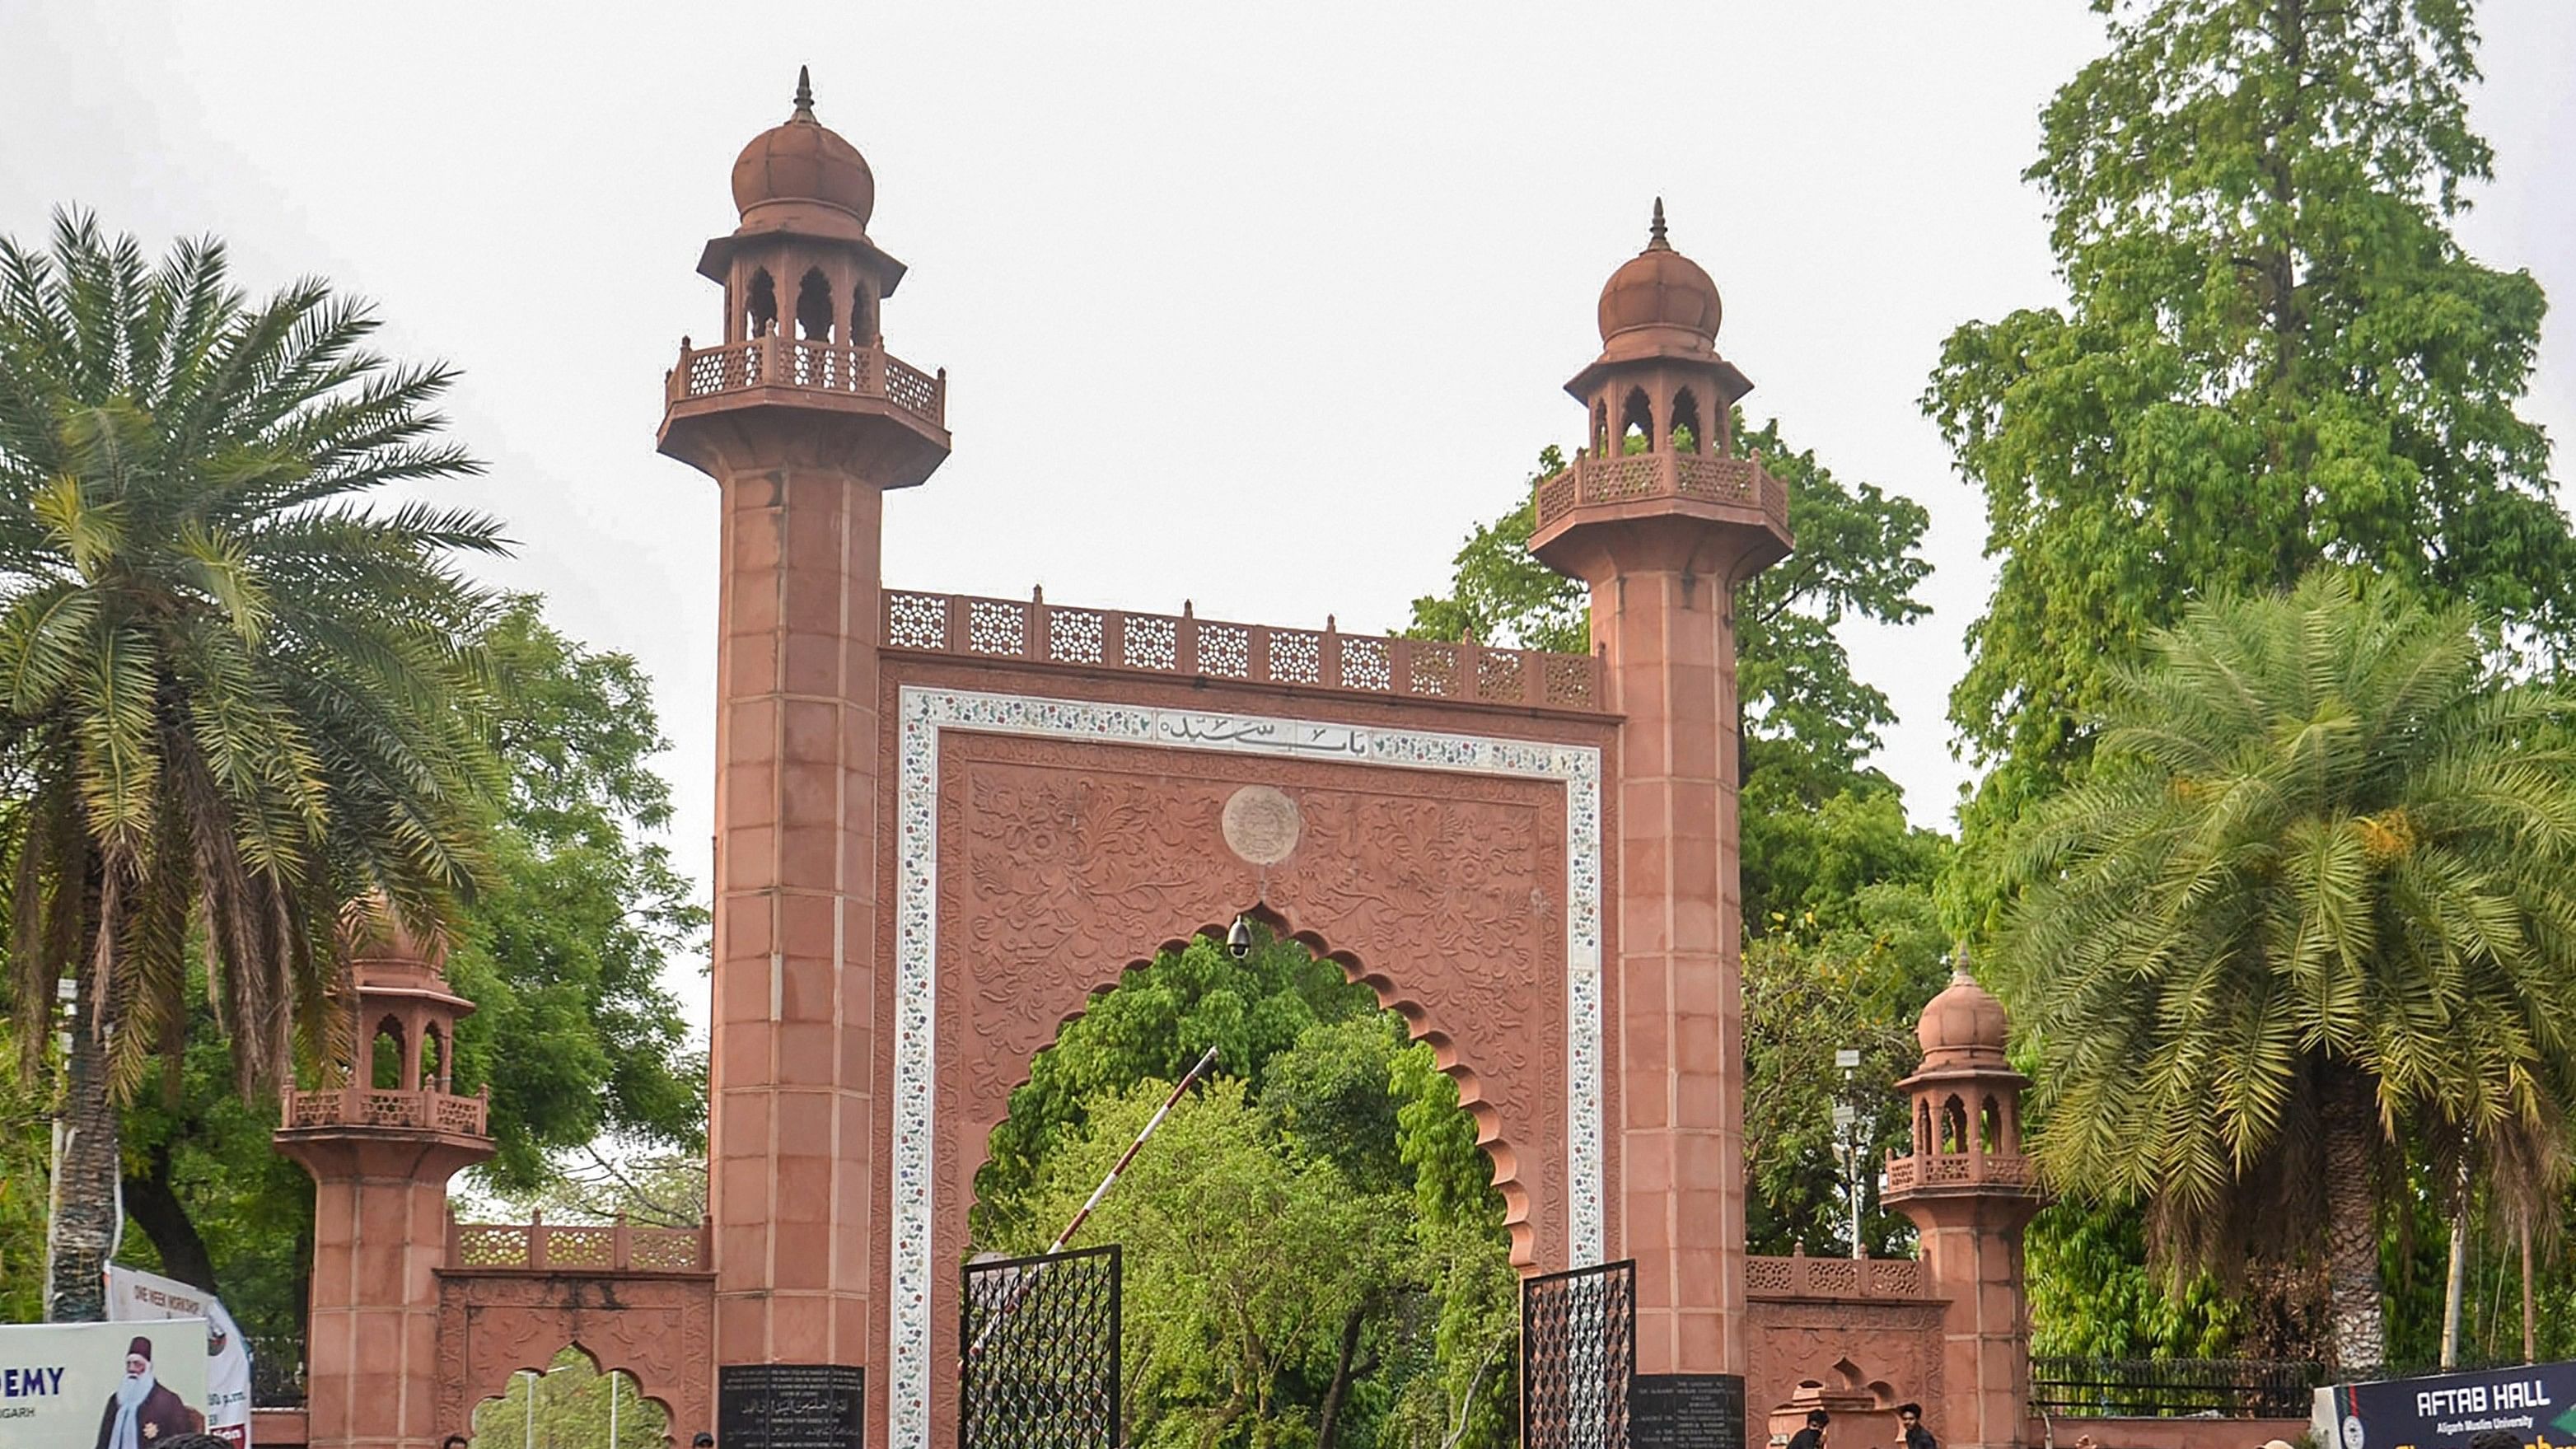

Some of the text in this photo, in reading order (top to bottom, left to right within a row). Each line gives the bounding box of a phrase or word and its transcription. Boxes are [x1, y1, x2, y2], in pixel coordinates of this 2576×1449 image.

[0, 1367, 64, 1397] EMY
[2416, 1380, 2551, 1418] AFTAB HALL
[2436, 1414, 2534, 1436] Aligarh Muslim University
